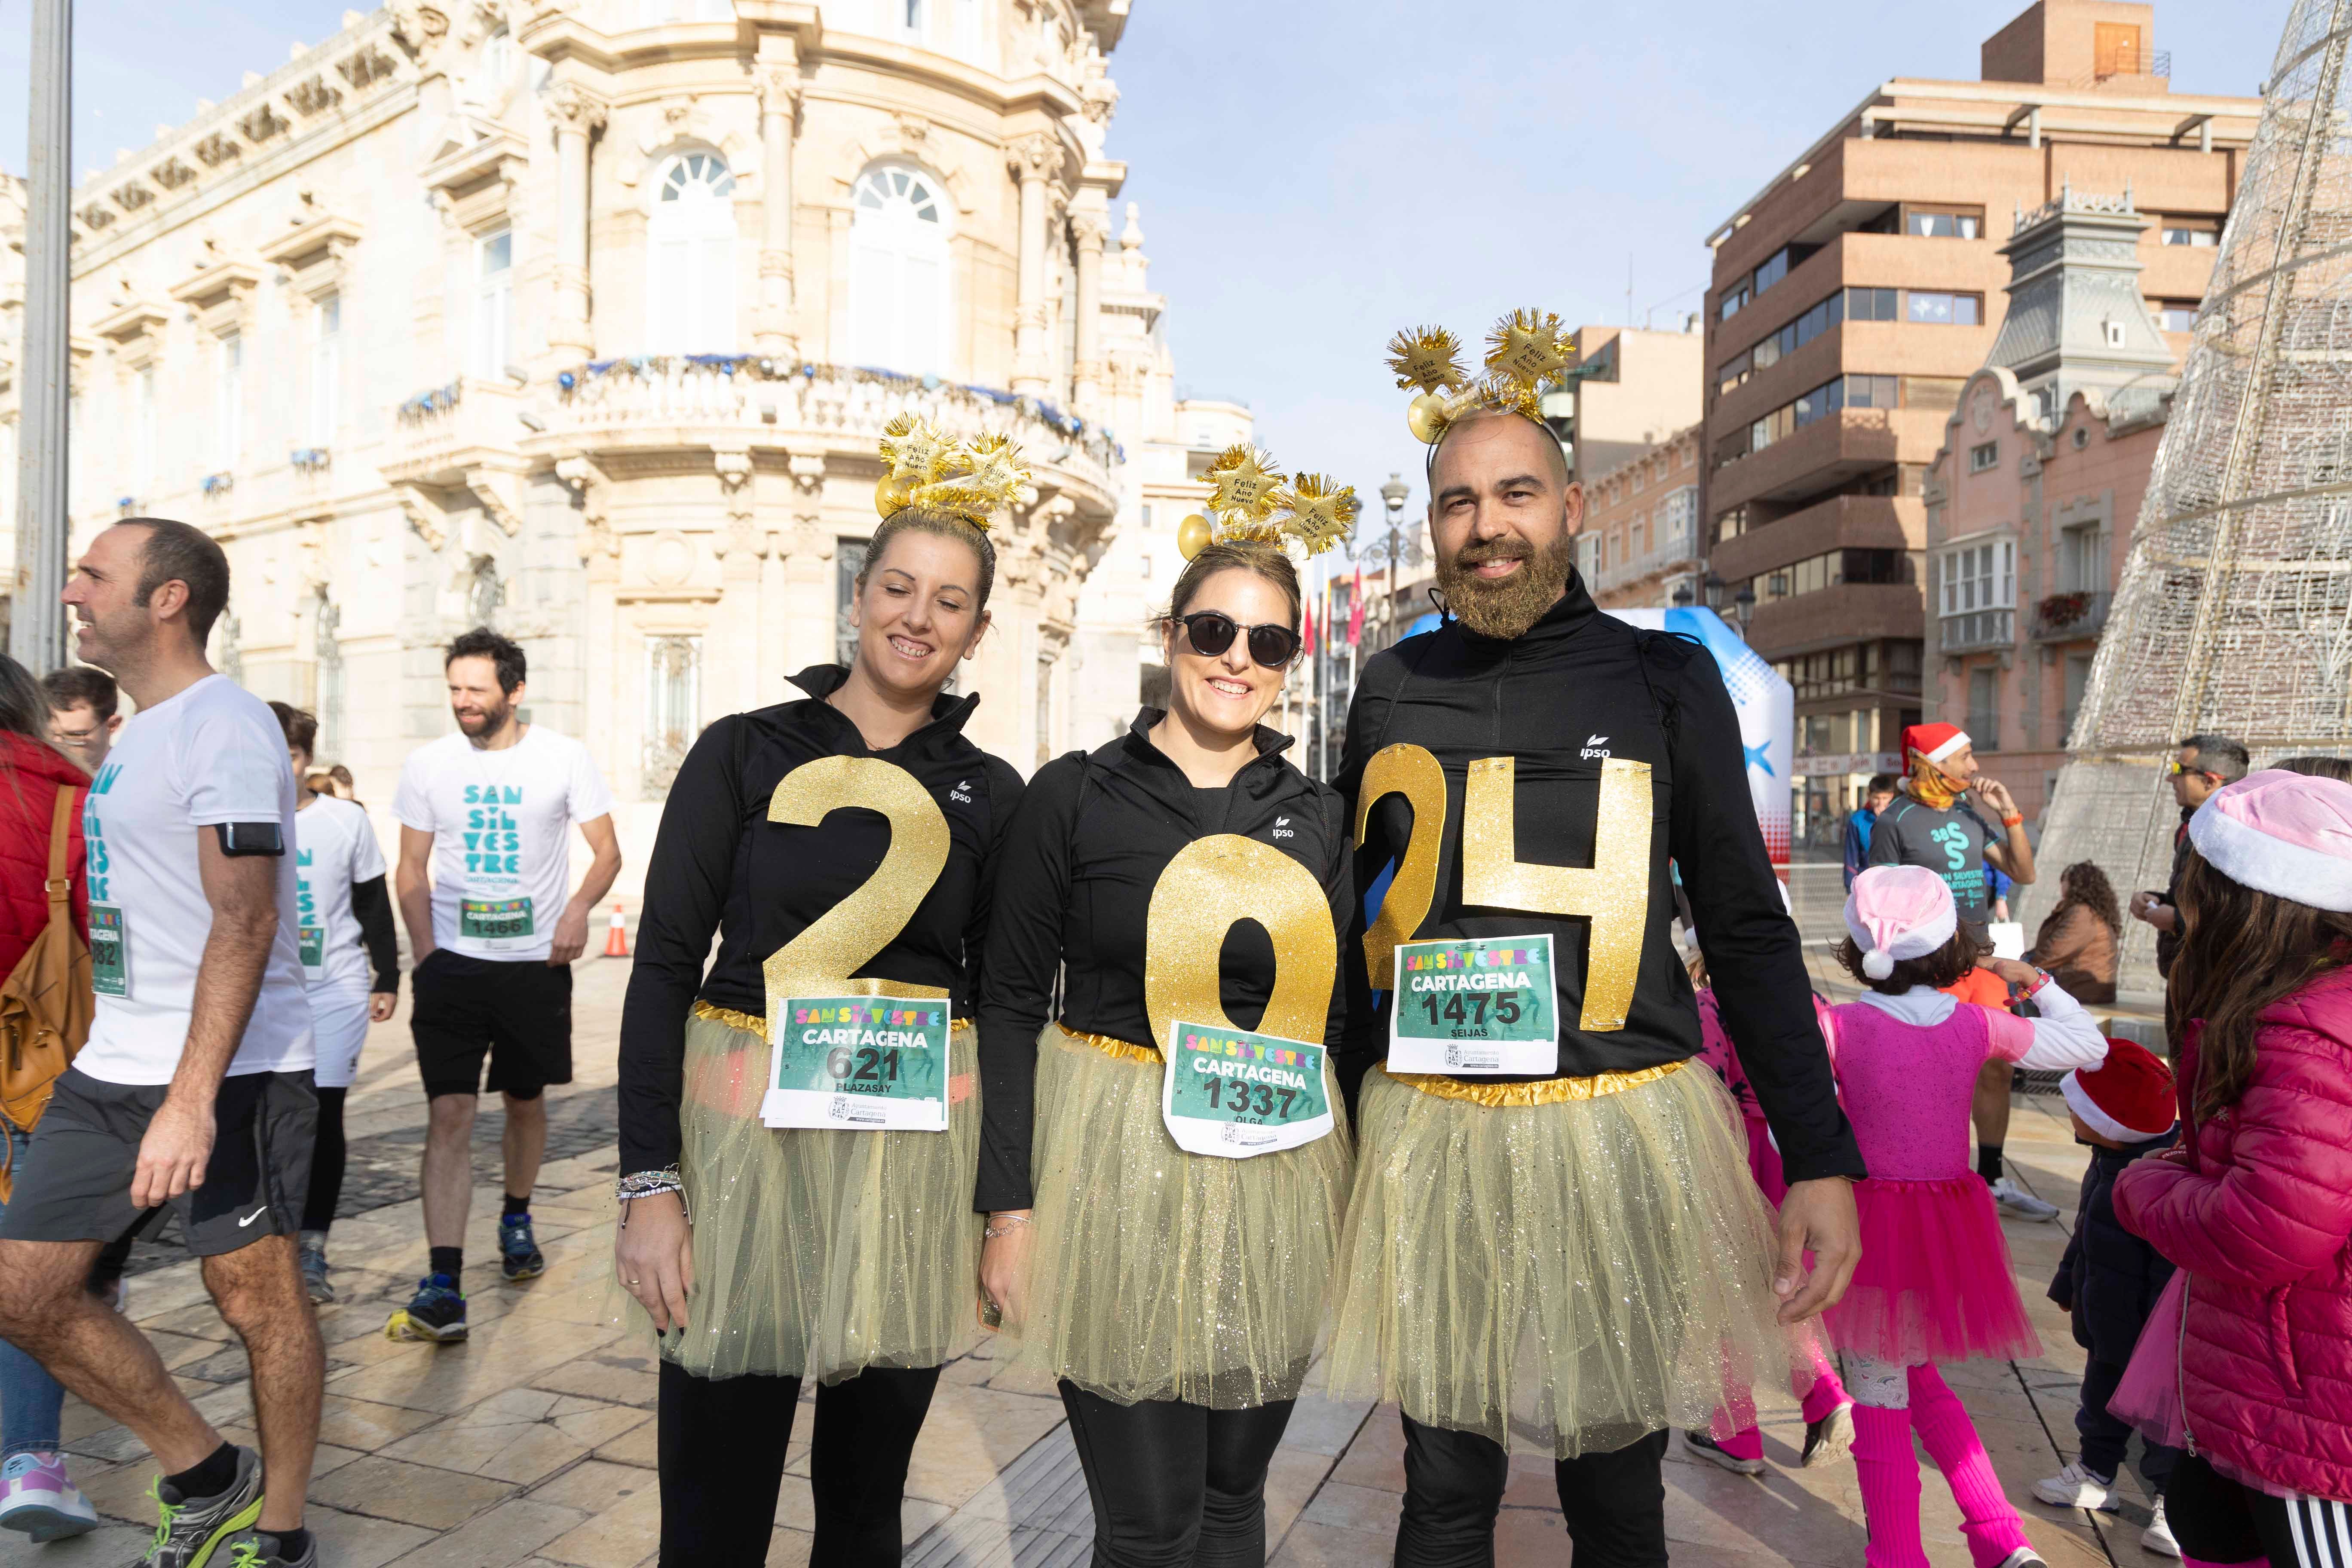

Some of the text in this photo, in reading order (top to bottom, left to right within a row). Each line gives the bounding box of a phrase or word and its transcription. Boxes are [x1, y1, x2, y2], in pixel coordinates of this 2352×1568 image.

[1523, 343, 1546, 362] Feliz
[1413, 360, 1435, 372] Feliz
[1513, 358, 1534, 375] Nuevo
[1520, 354, 1537, 368] Año
[1422, 369, 1438, 377] Año
[1423, 374, 1445, 384] Nuevo
[907, 444, 929, 455] Feliz
[909, 454, 925, 462] Año
[905, 461, 927, 470] Nuevo
[985, 464, 1005, 478] Feliz
[1234, 478, 1257, 489] Feliz
[1235, 488, 1252, 496] Año
[1231, 495, 1253, 504] Nuevo
[1305, 518, 1320, 530] Año
[1308, 508, 1328, 526] Feliz
[464, 785, 522, 804] SAN
[462, 832, 520, 851] VES
[1930, 827, 1950, 842] 38
[466, 853, 520, 873] TRE
[1947, 879, 1983, 889] ARTAGENA
[763, 754, 951, 1046] 2
[466, 911, 527, 921] CARTAGENA
[1145, 833, 1338, 1063] 0
[1407, 953, 1433, 971] SAN
[1411, 972, 1532, 992] CARTAGENA
[1422, 992, 1521, 1025] 1475
[796, 1008, 835, 1024] SAN
[802, 1029, 928, 1048] CARTAGENA
[1451, 1029, 1488, 1037] SEIJAS
[1185, 1035, 1223, 1054] SAN
[827, 1047, 898, 1081] 621
[1193, 1057, 1307, 1090] CARTAGENA
[836, 1083, 892, 1093] PLAZASAY
[1204, 1078, 1297, 1118] 1337
[851, 1109, 886, 1118] Cartagena
[1235, 1116, 1263, 1125] OLGA
